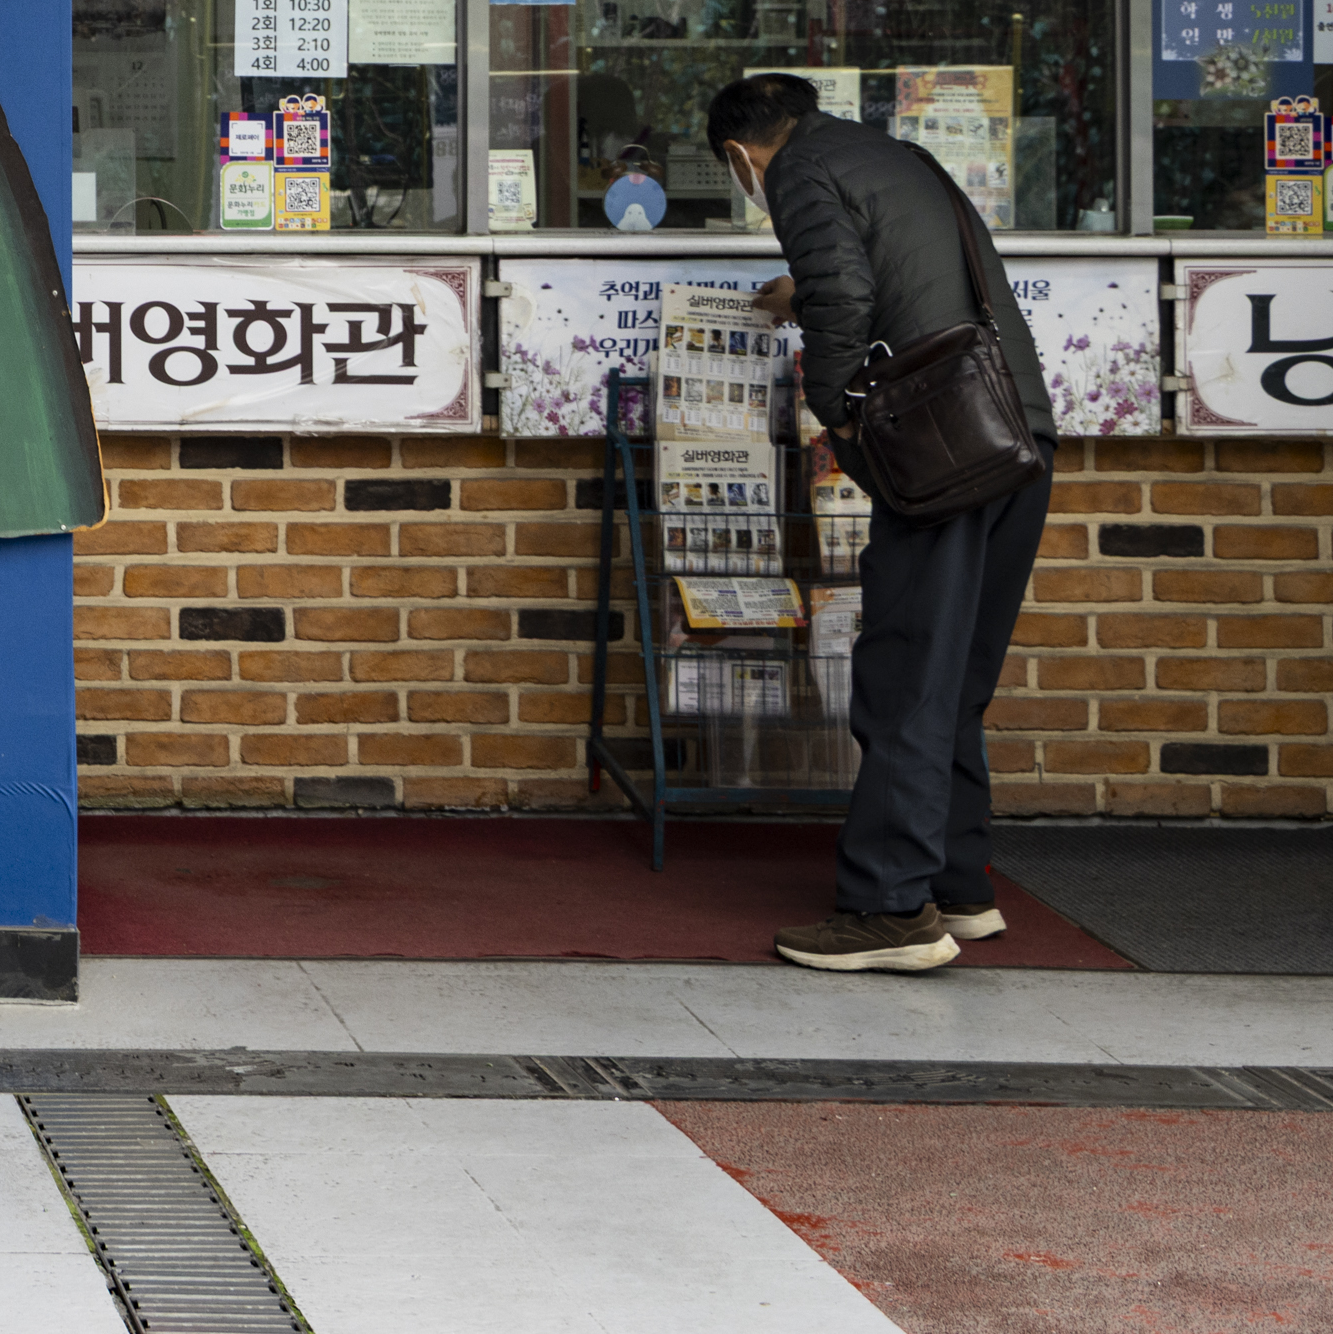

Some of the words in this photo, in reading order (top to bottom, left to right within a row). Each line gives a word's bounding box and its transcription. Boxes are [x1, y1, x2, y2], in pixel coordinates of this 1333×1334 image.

[1215, 2, 1233, 20] 생
[251, 15, 277, 32] 2회
[289, 18, 331, 32] 12:20
[251, 35, 277, 52] 3회
[296, 37, 331, 51] 2:10
[251, 55, 277, 72] 4회
[296, 57, 331, 71] 4:00
[229, 183, 265, 194] 문화누리
[680, 448, 750, 464] 실버영화관
